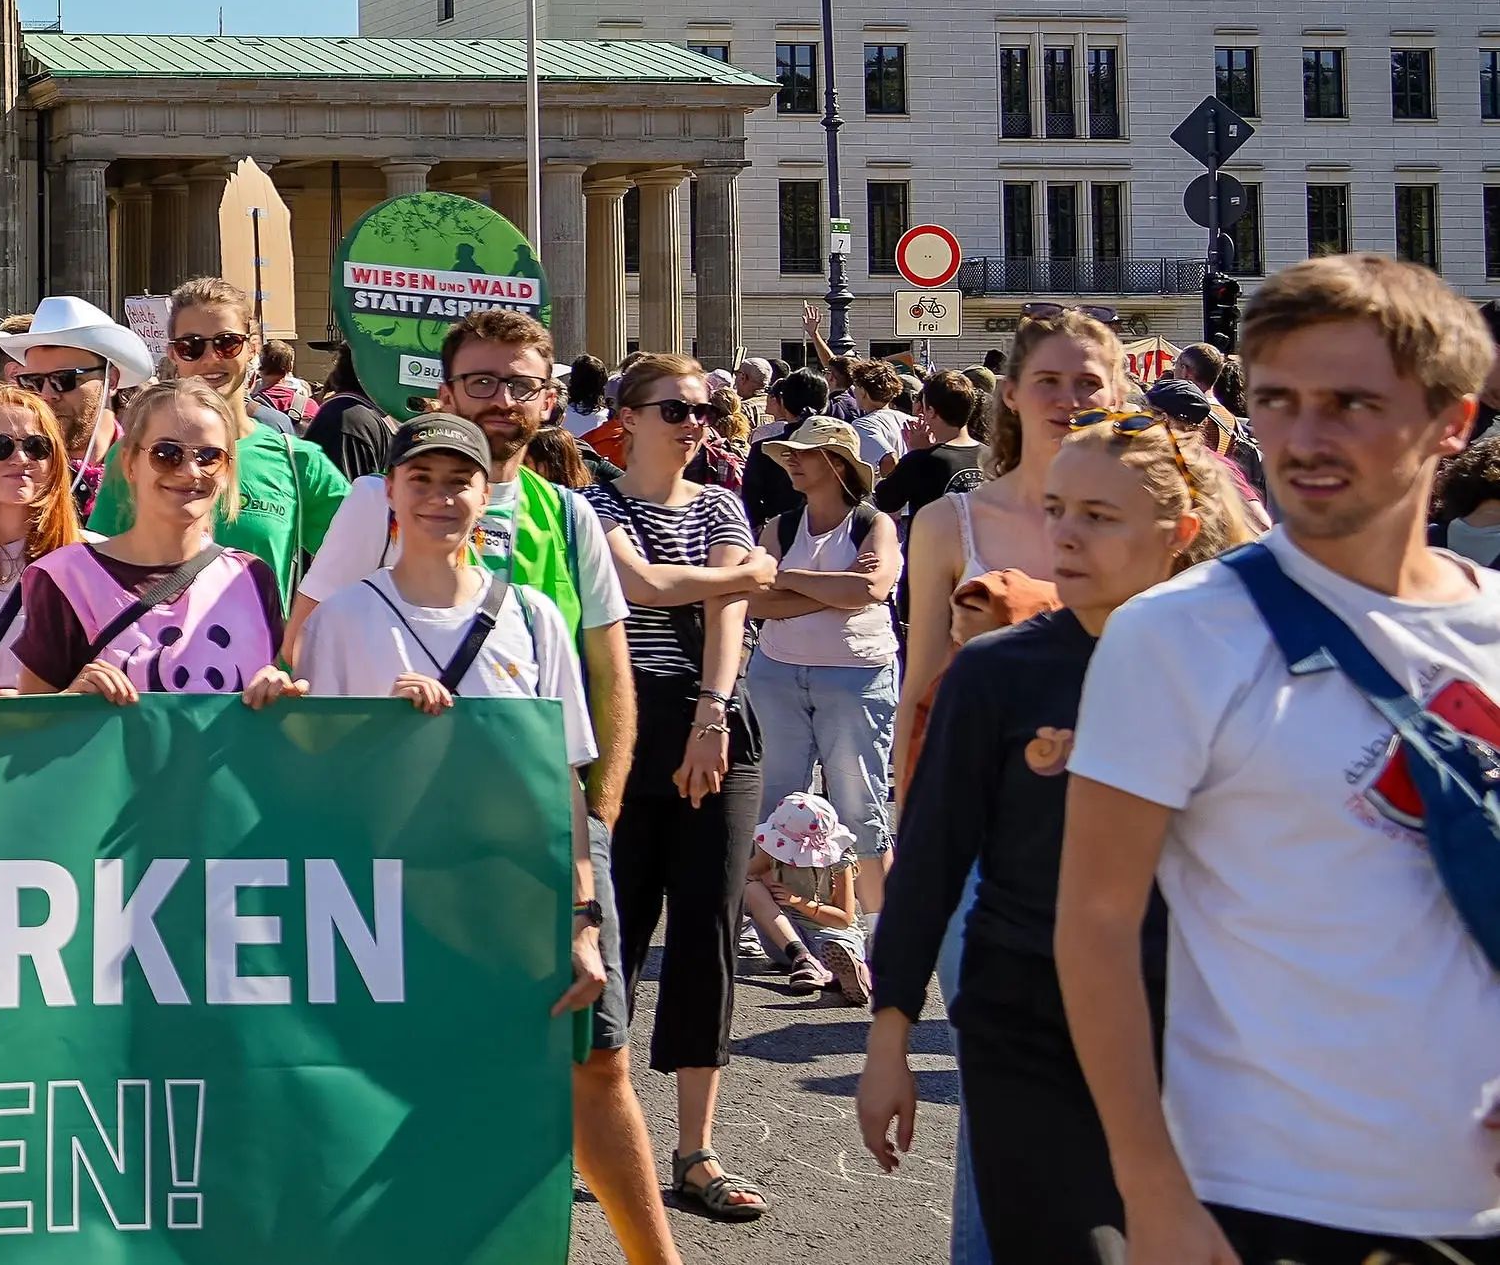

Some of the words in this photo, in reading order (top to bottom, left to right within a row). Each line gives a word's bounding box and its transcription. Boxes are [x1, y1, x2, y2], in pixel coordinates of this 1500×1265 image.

[838, 239, 844, 249] 7
[351, 267, 435, 291] WIESEN
[439, 282, 465, 293] UND
[468, 278, 533, 299] WALD
[354, 291, 423, 313] STATT
[917, 320, 939, 332] frei
[424, 367, 441, 378] BU
[251, 499, 286, 516] BUND
